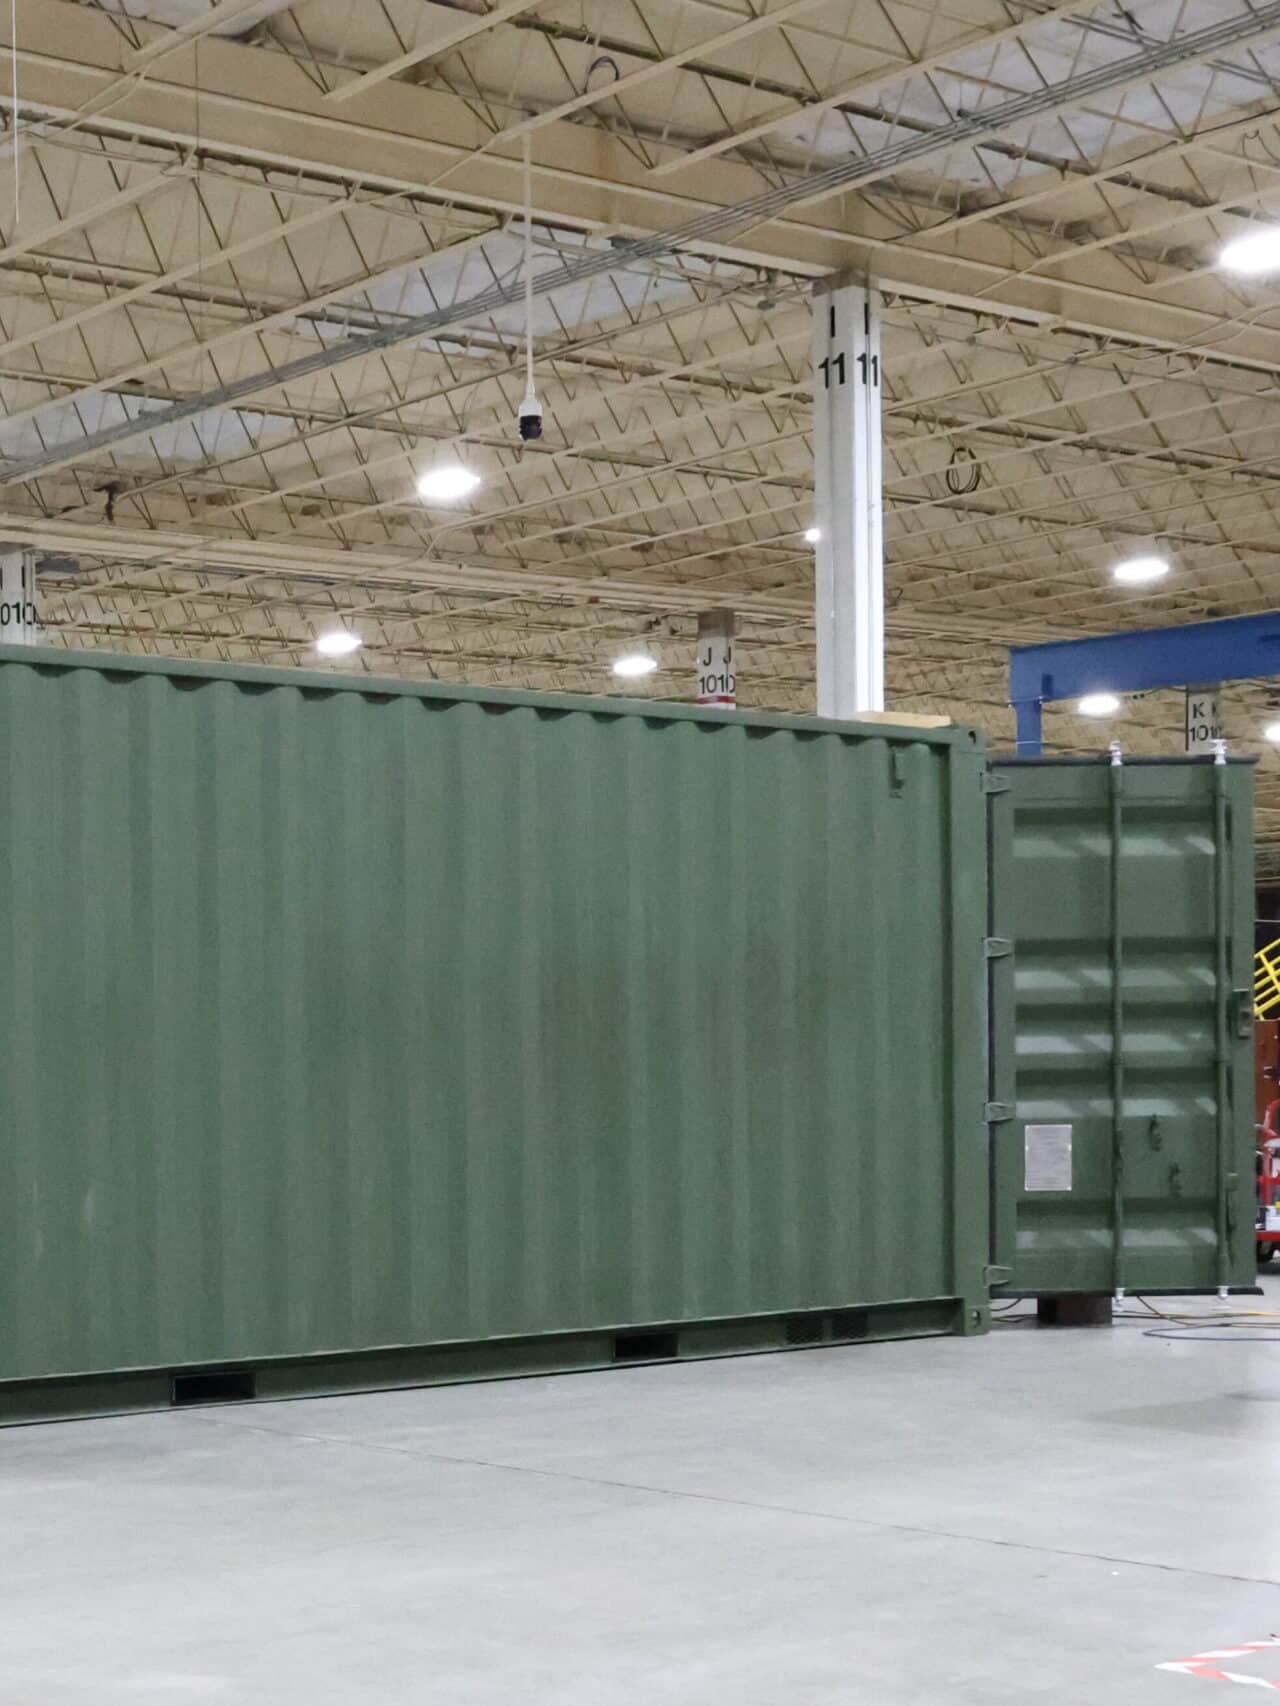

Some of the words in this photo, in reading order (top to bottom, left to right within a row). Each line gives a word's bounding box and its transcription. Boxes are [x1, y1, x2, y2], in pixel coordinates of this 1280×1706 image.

[818, 352, 846, 389] 11
[856, 353, 878, 387] 11
[11, 602, 37, 626] 10
[703, 646, 713, 666] J
[723, 645, 732, 665] J
[699, 675, 717, 695] 10
[717, 674, 736, 693] 10
[1192, 702, 1205, 719] K
[1190, 725, 1209, 741] 10
